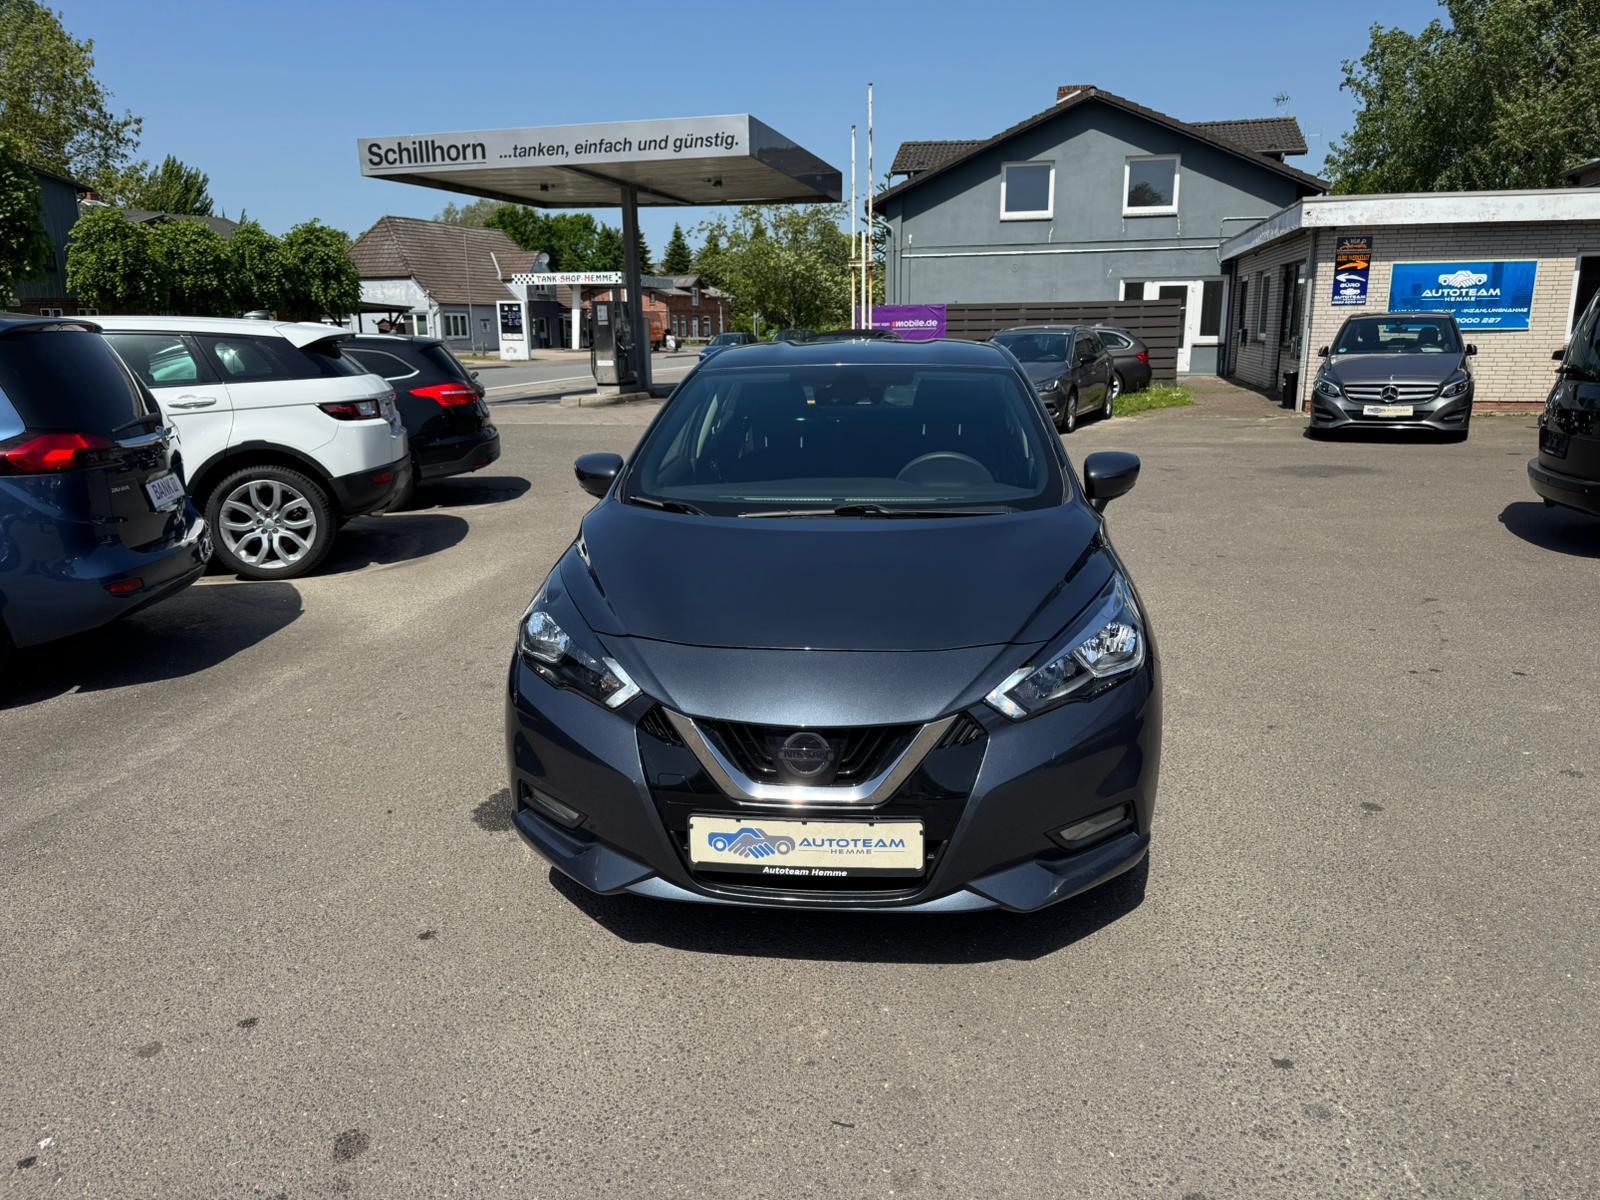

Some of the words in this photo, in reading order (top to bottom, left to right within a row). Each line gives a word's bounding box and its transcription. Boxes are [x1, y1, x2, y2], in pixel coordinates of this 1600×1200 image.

[367, 139, 486, 166] Schillhorn
[574, 137, 632, 155] einfach
[637, 135, 669, 151] und
[673, 131, 739, 152] günstig.
[584, 274, 613, 282] HEMME
[1421, 288, 1500, 297] AUTOTEAM
[896, 319, 938, 327] mobile.de
[799, 837, 906, 848] AUTOTEAM
[762, 866, 809, 876] Autoteam
[811, 868, 848, 877] Hemme
